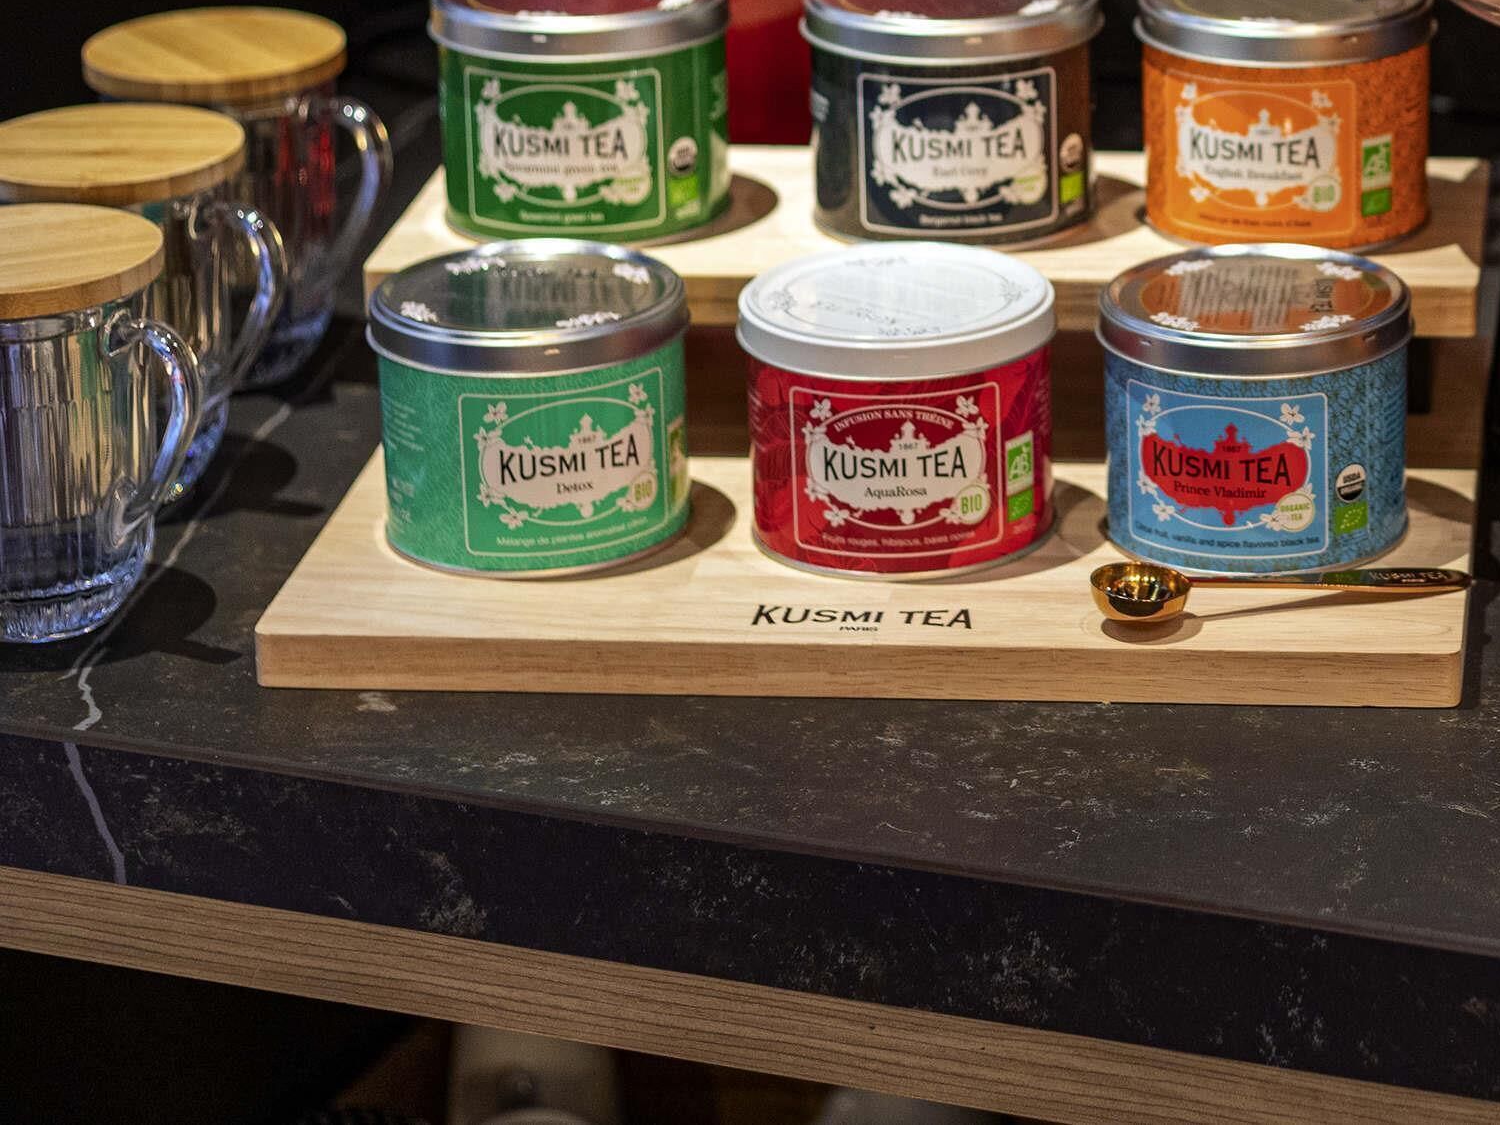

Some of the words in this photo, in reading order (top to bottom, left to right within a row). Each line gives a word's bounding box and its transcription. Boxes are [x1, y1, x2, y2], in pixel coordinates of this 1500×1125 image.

[494, 126, 570, 158] KUSMI
[578, 127, 628, 161] TEA
[892, 130, 972, 163] KUSMI
[981, 126, 1027, 159] TEA
[1189, 128, 1263, 161] KUSMI
[1272, 137, 1321, 169] TEA
[1313, 184, 1335, 204] BIO
[833, 409, 883, 433] INFUSION
[884, 409, 914, 420] SANS
[499, 450, 586, 485] KUSMI
[594, 433, 640, 469] TEA
[823, 446, 907, 482] KUSMI
[916, 445, 967, 478] TEA
[1153, 441, 1230, 480] KUSMI
[1239, 453, 1291, 487] TEA
[556, 481, 594, 495] Detox
[633, 478, 653, 502] BIO
[864, 486, 927, 499] AquaRosa
[1173, 480, 1210, 496] Prince
[1213, 485, 1267, 499] Vladimir
[960, 494, 983, 515] BIO
[1290, 513, 1303, 521] TEA
[1197, 537, 1215, 547] and
[1216, 538, 1241, 548] spice
[1242, 538, 1279, 548] flavored
[1280, 537, 1303, 548] black
[1306, 536, 1320, 544] tea
[751, 604, 885, 626] KUSMI
[899, 608, 973, 630] TEA
